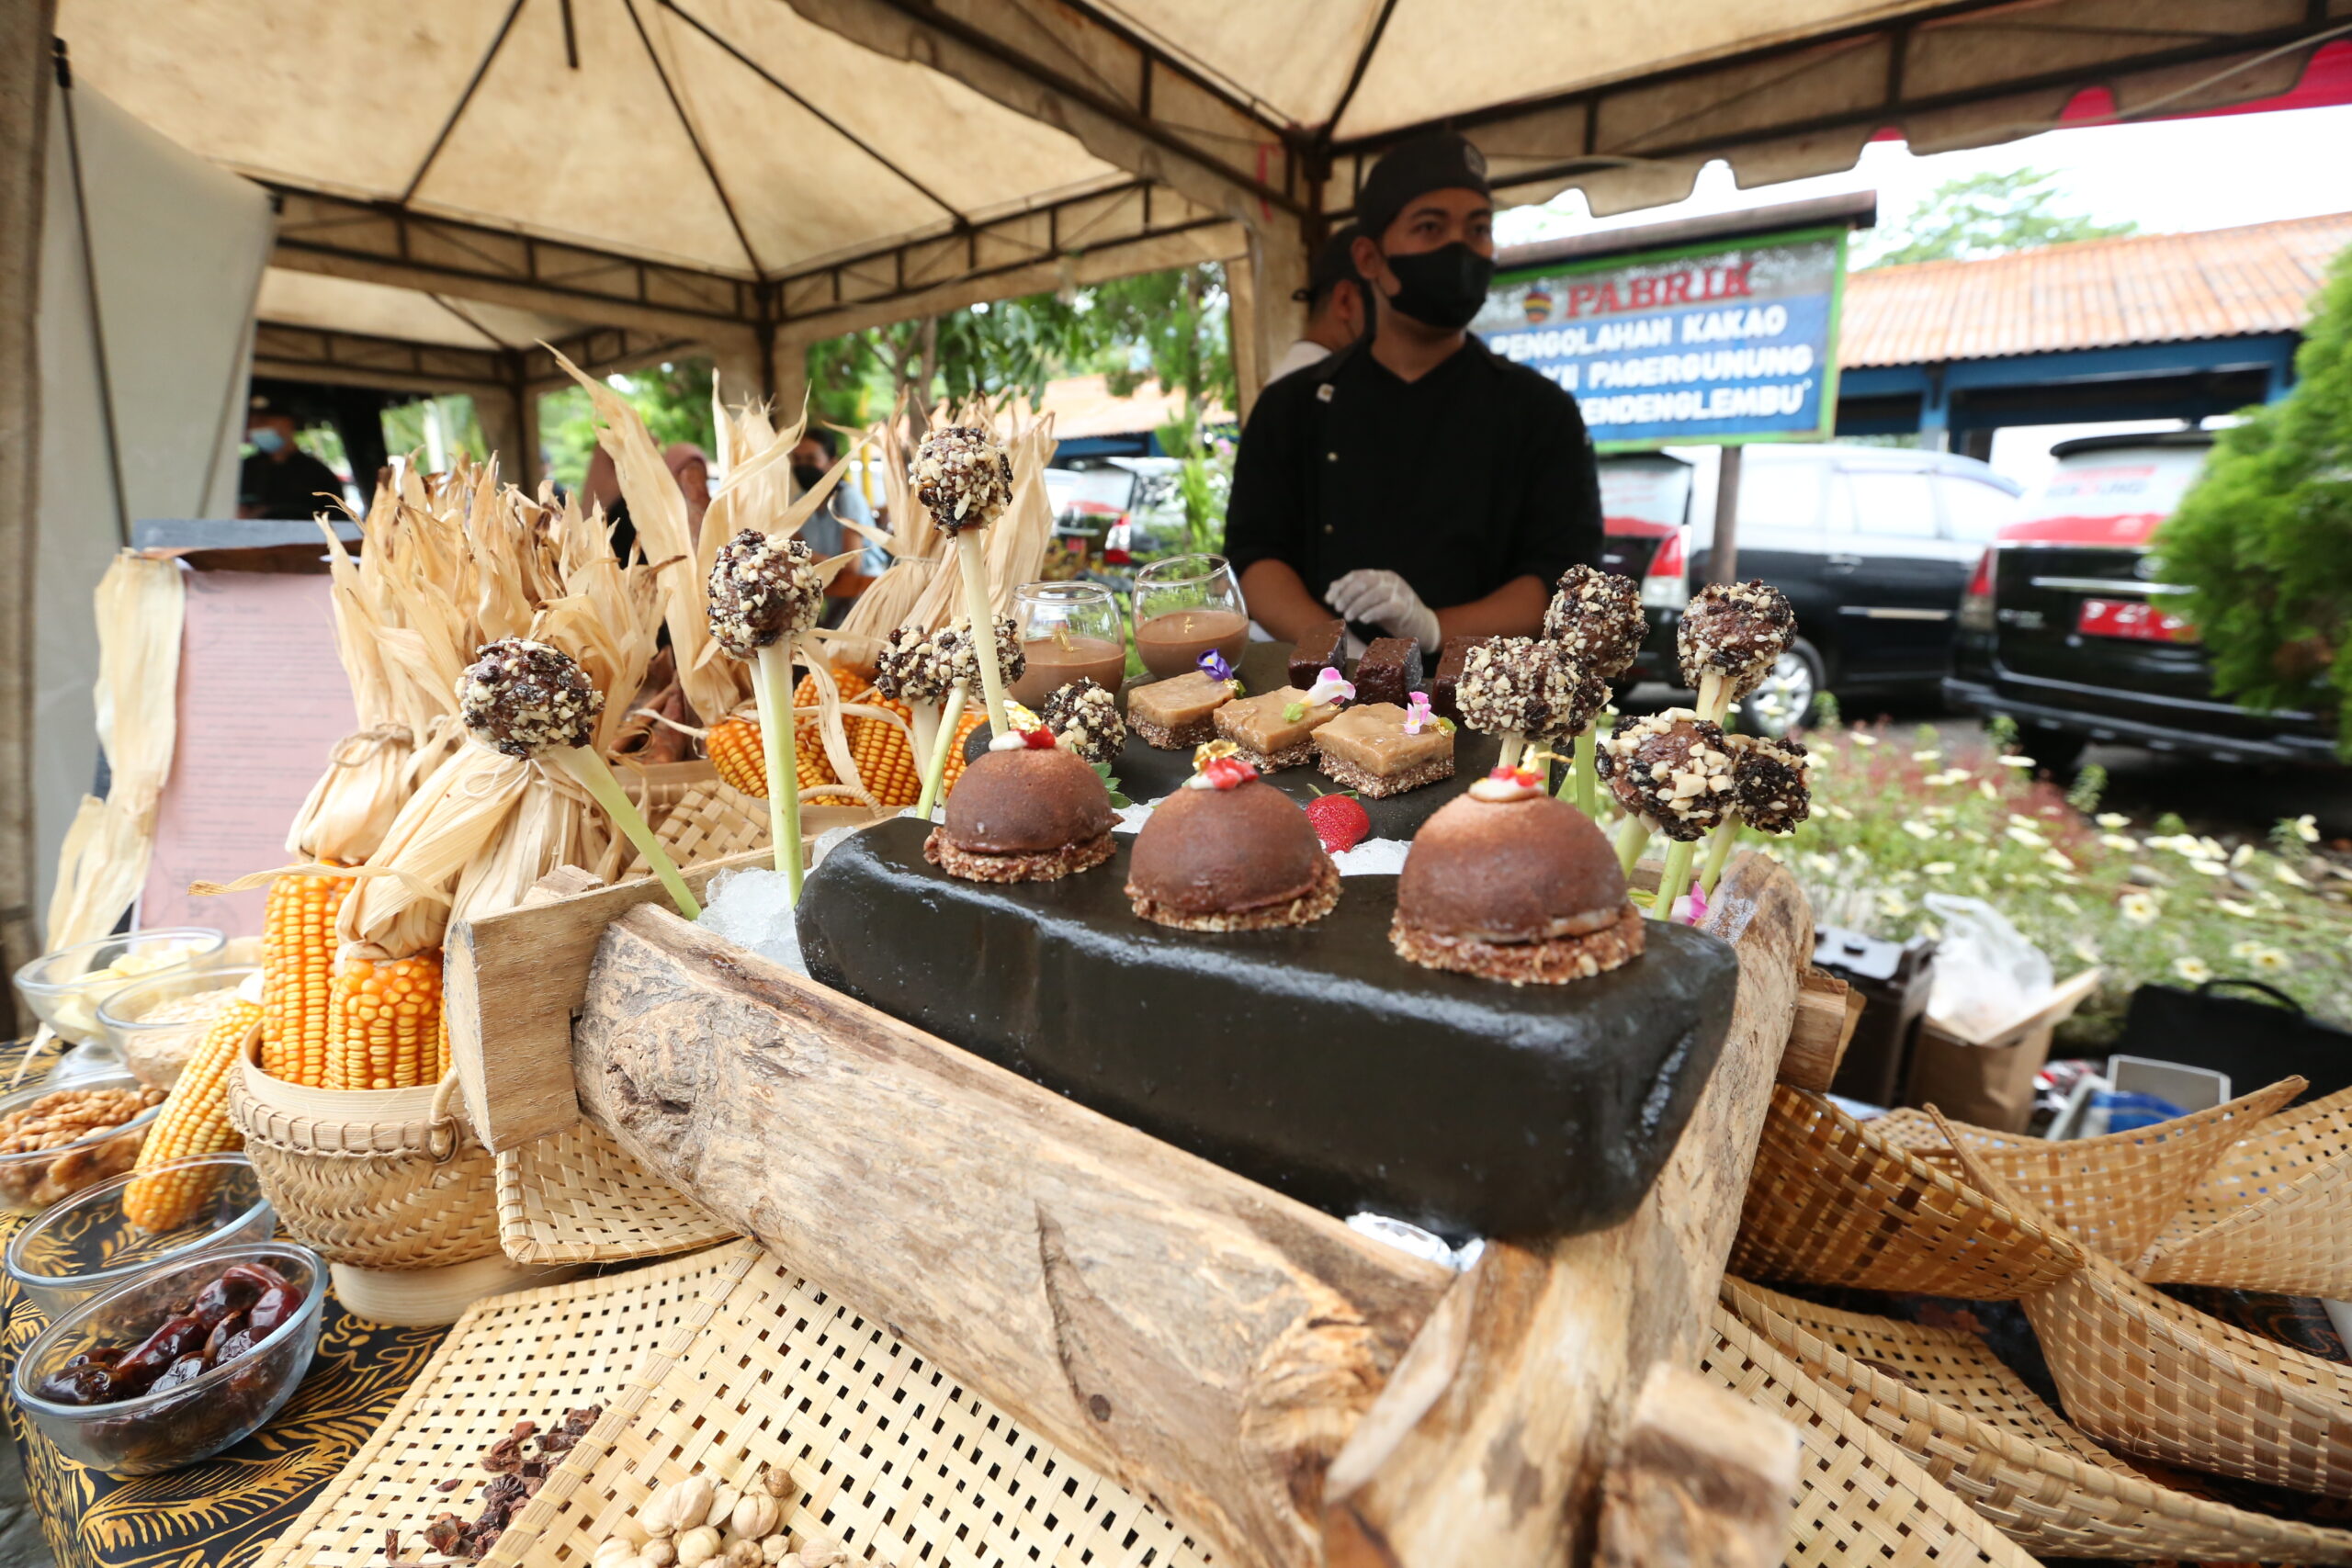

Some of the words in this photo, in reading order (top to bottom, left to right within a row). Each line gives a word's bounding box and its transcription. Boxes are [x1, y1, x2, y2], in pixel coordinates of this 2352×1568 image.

[1566, 262, 1754, 318] PABRIK
[1489, 316, 1672, 362] PENGOLAHAN
[1680, 304, 1788, 344] KAKAO
[1588, 343, 1814, 389] PAGERGUNUNG
